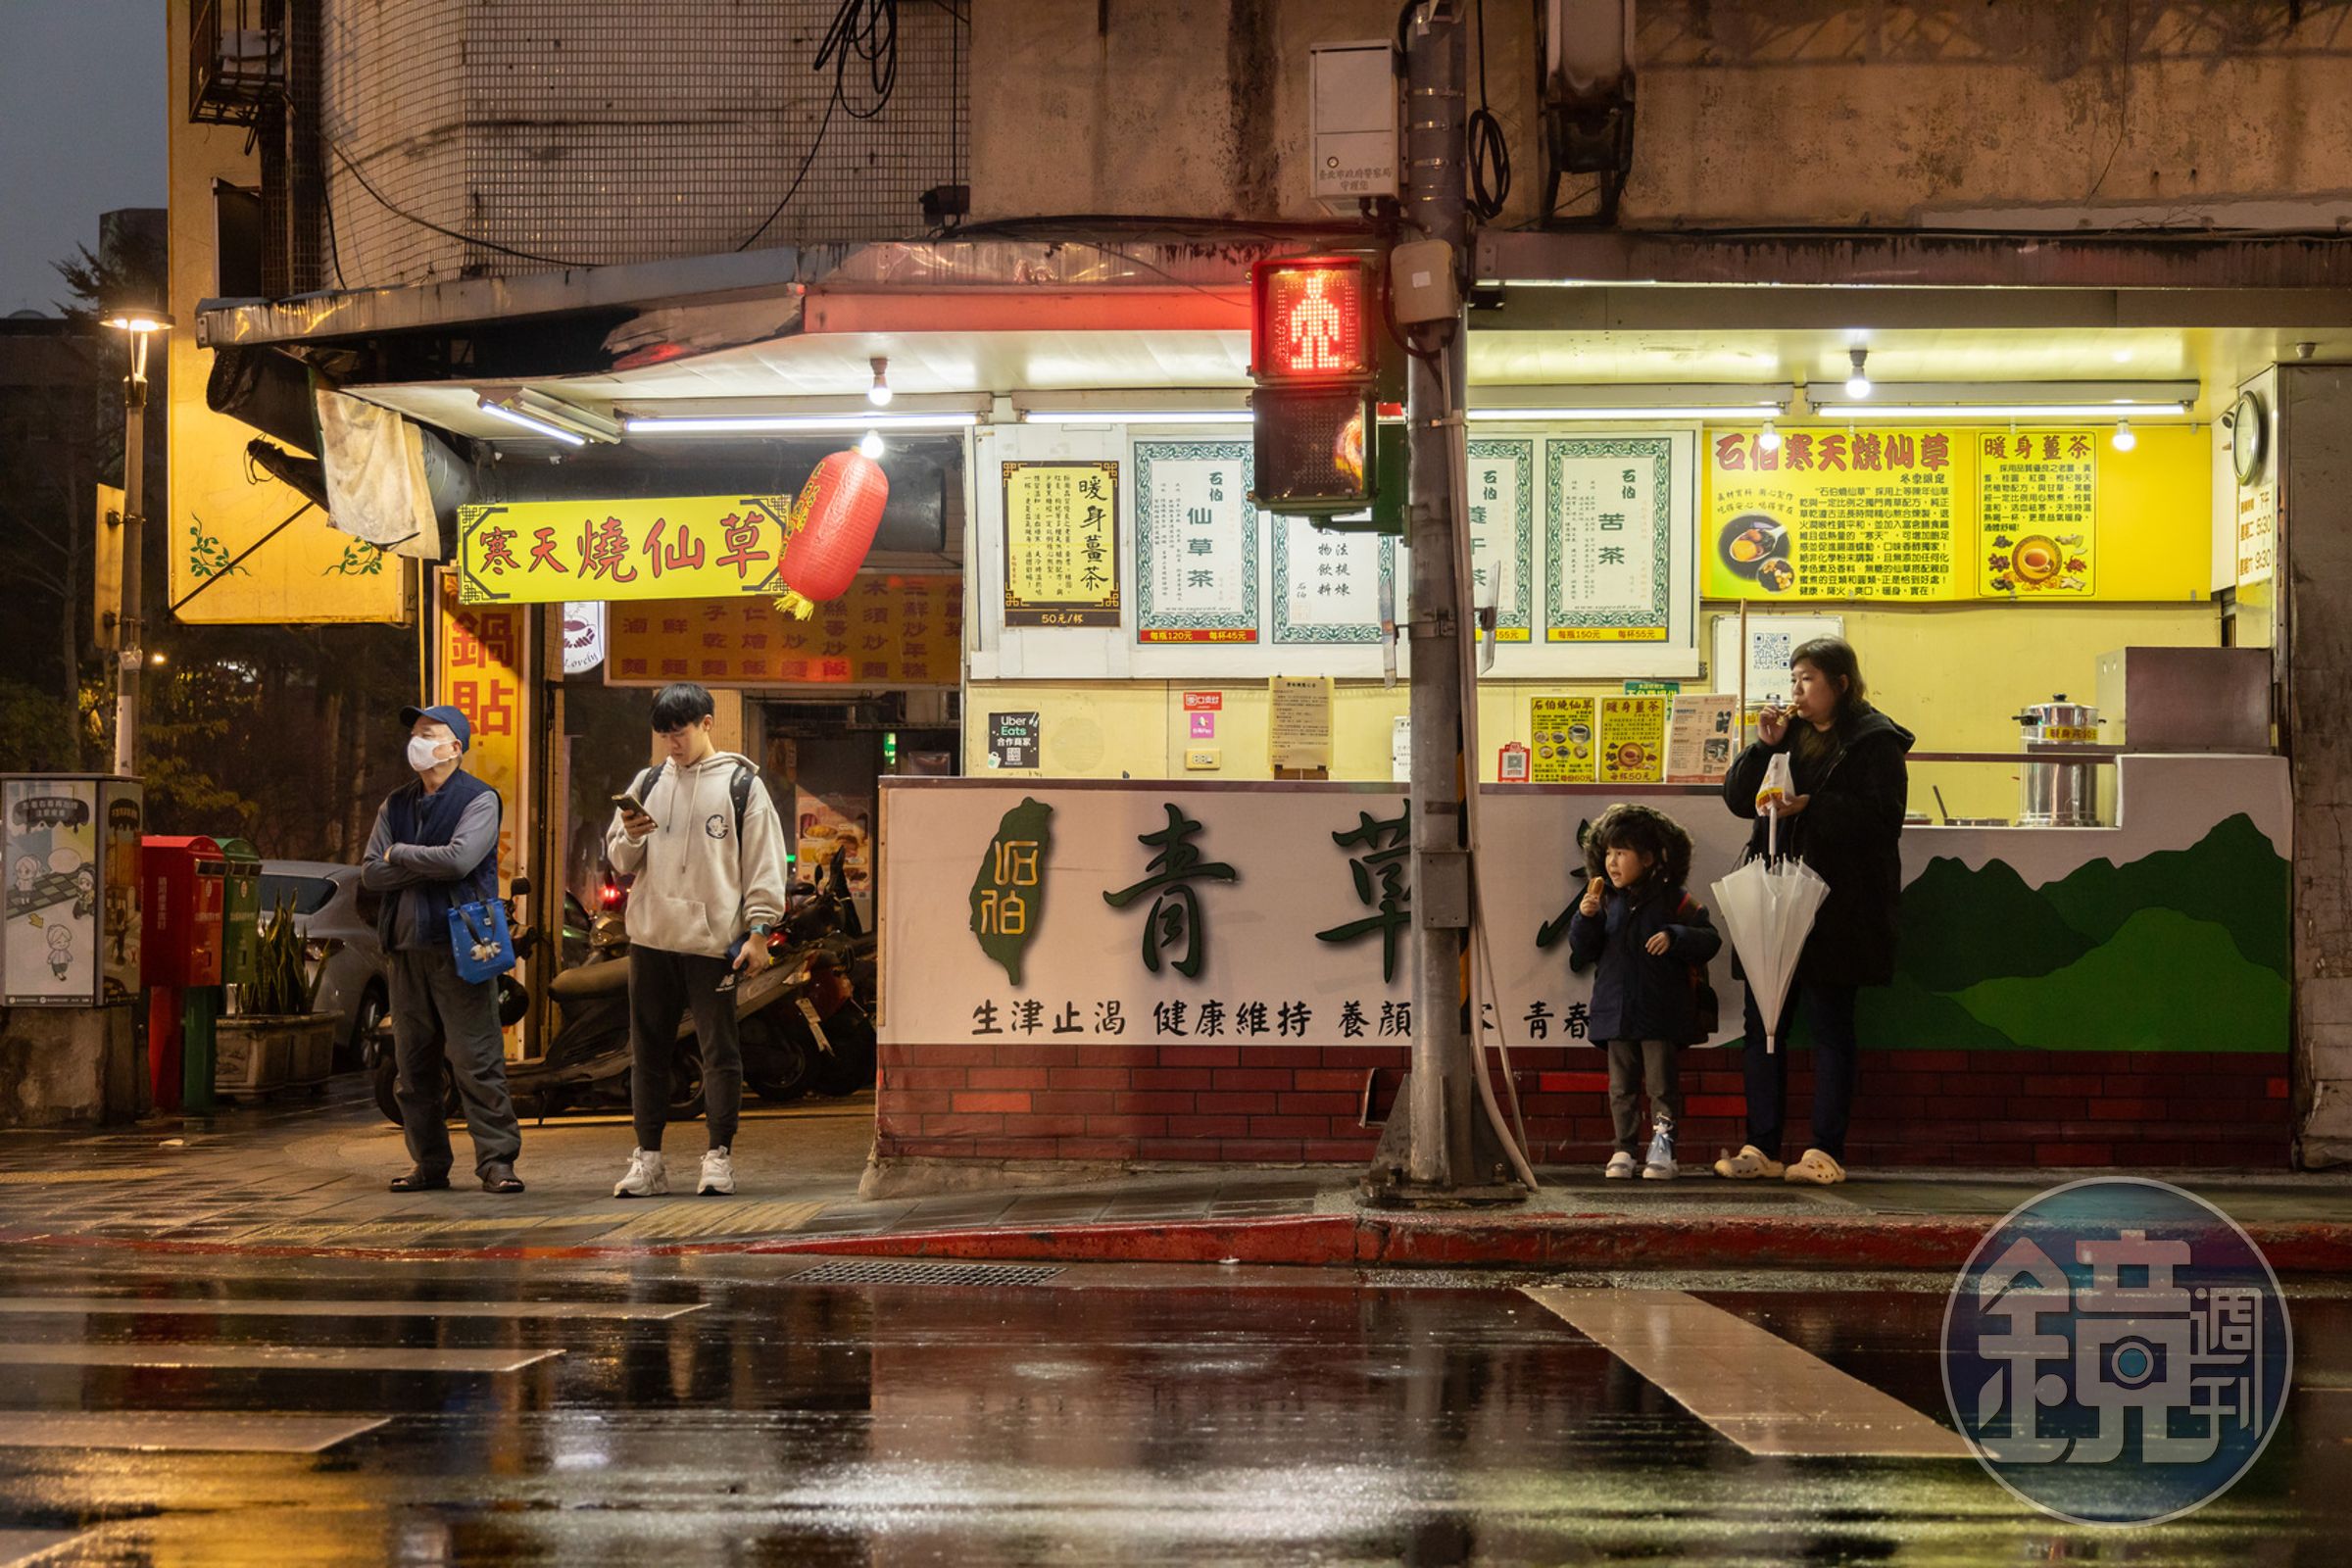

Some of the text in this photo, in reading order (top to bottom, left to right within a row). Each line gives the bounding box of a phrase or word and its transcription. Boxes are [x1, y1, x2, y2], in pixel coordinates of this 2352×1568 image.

[1716, 433, 1950, 471] 石伯寒天燒仙草
[1984, 435, 2091, 460] 暖身薑茶
[1209, 471, 1223, 502] 石伯
[1483, 469, 1497, 501] 石伯
[1622, 469, 1636, 500] 石伯
[1899, 472, 1945, 484] 冬季限定
[1079, 475, 1108, 591] 暖身薑茶
[1598, 513, 1625, 565] 苦茶
[2256, 514, 2272, 536] 5:30
[479, 513, 771, 583] 寒天燒仙草
[1187, 508, 1214, 588] 仙草茶
[1317, 529, 1333, 597] 物飲料
[1335, 531, 1350, 597] 法提煉
[2255, 549, 2272, 570] 9:30
[1042, 613, 1084, 624] 50元/杯
[1558, 629, 1655, 640] 每瓶150元 每杯55元
[620, 616, 648, 676] 滷麵
[662, 617, 688, 676] 鮮麵
[702, 605, 728, 676] 子乾麵
[741, 606, 767, 676] 仁燴飯
[822, 600, 848, 677] 絲蛋炒飯
[1150, 630, 1247, 640] 每瓶120元 每杯45元
[1494, 630, 1519, 640] 55元
[451, 611, 514, 737] 鍋貼
[1001, 715, 1026, 725] Uber
[1605, 701, 1660, 713] 暖身薑茶
[997, 737, 1031, 747] 合作商家
[1001, 726, 1027, 736] Eats
[972, 999, 1126, 1037] 生津止渴
[1152, 999, 1312, 1039] 健康維持
